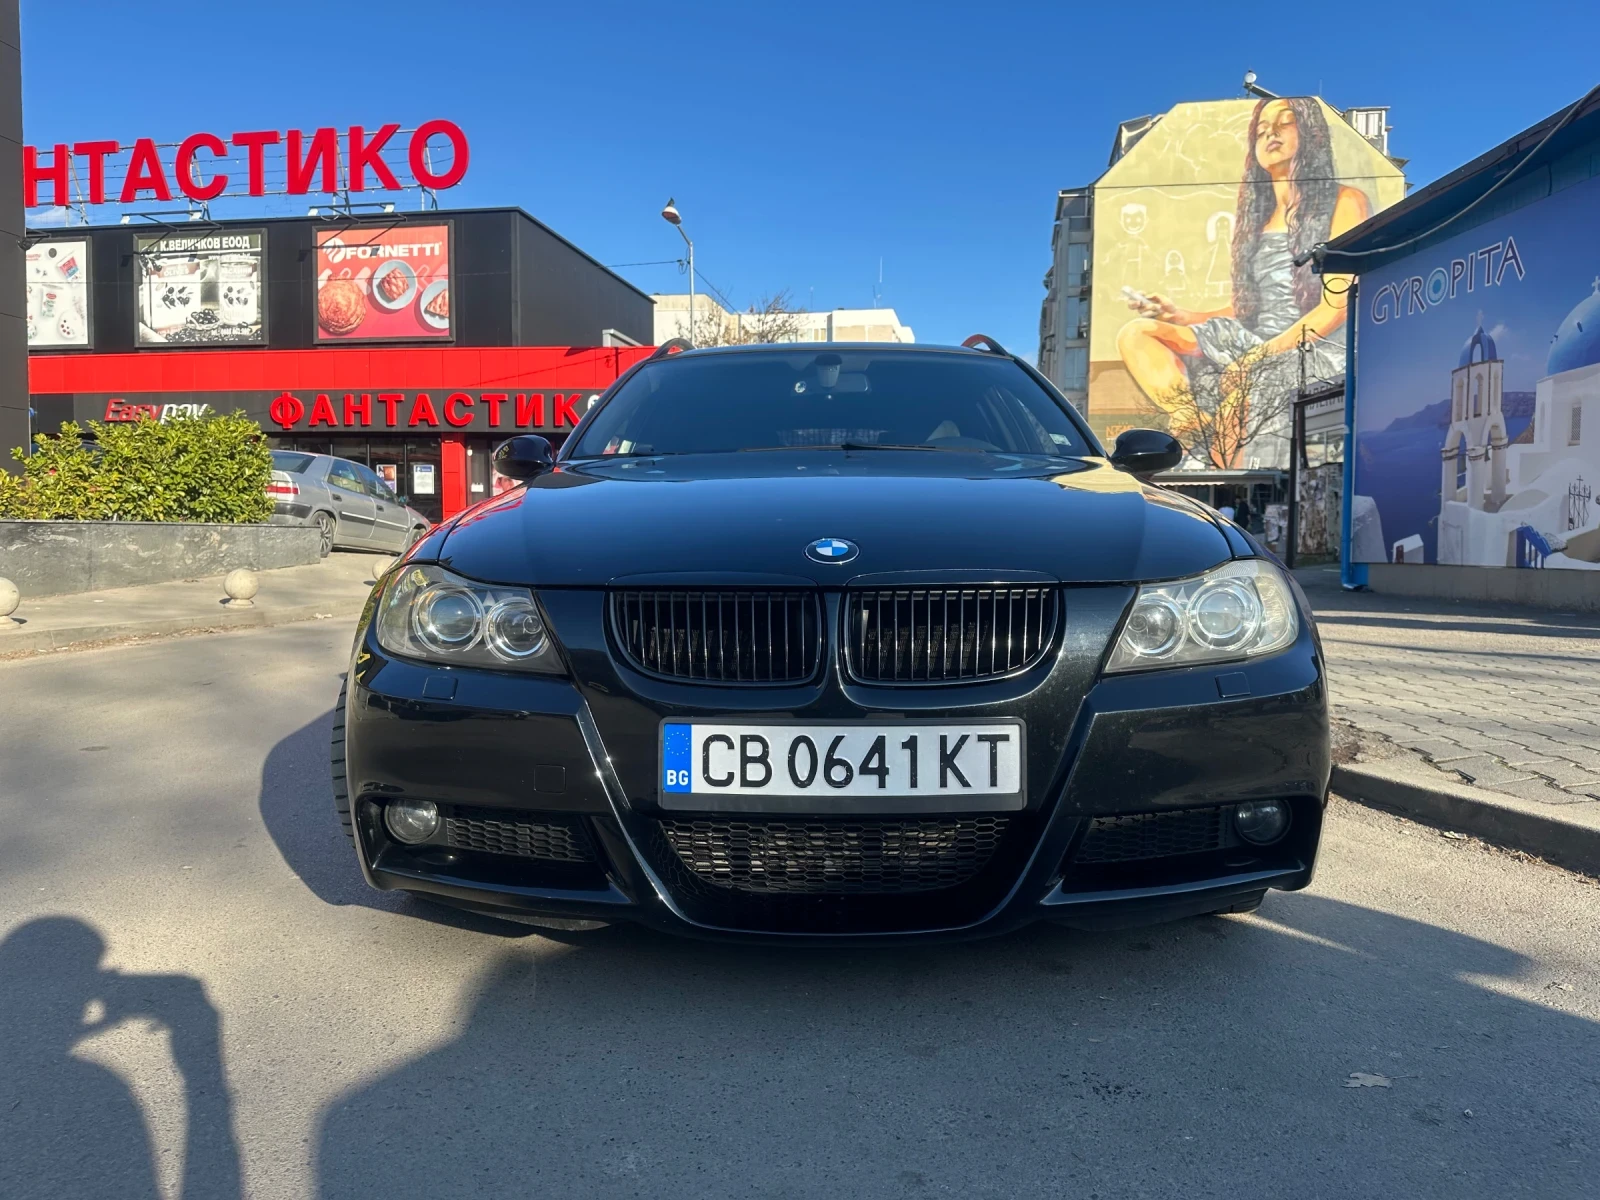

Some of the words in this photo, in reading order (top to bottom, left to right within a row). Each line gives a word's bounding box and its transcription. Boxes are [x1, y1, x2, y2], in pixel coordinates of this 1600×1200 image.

[222, 236, 250, 249] ЕООД
[1371, 237, 1525, 324] GYROPITA
[666, 769, 689, 786] BG
[702, 734, 773, 788] CB
[787, 735, 918, 788] 0641
[939, 734, 1010, 788] KT
